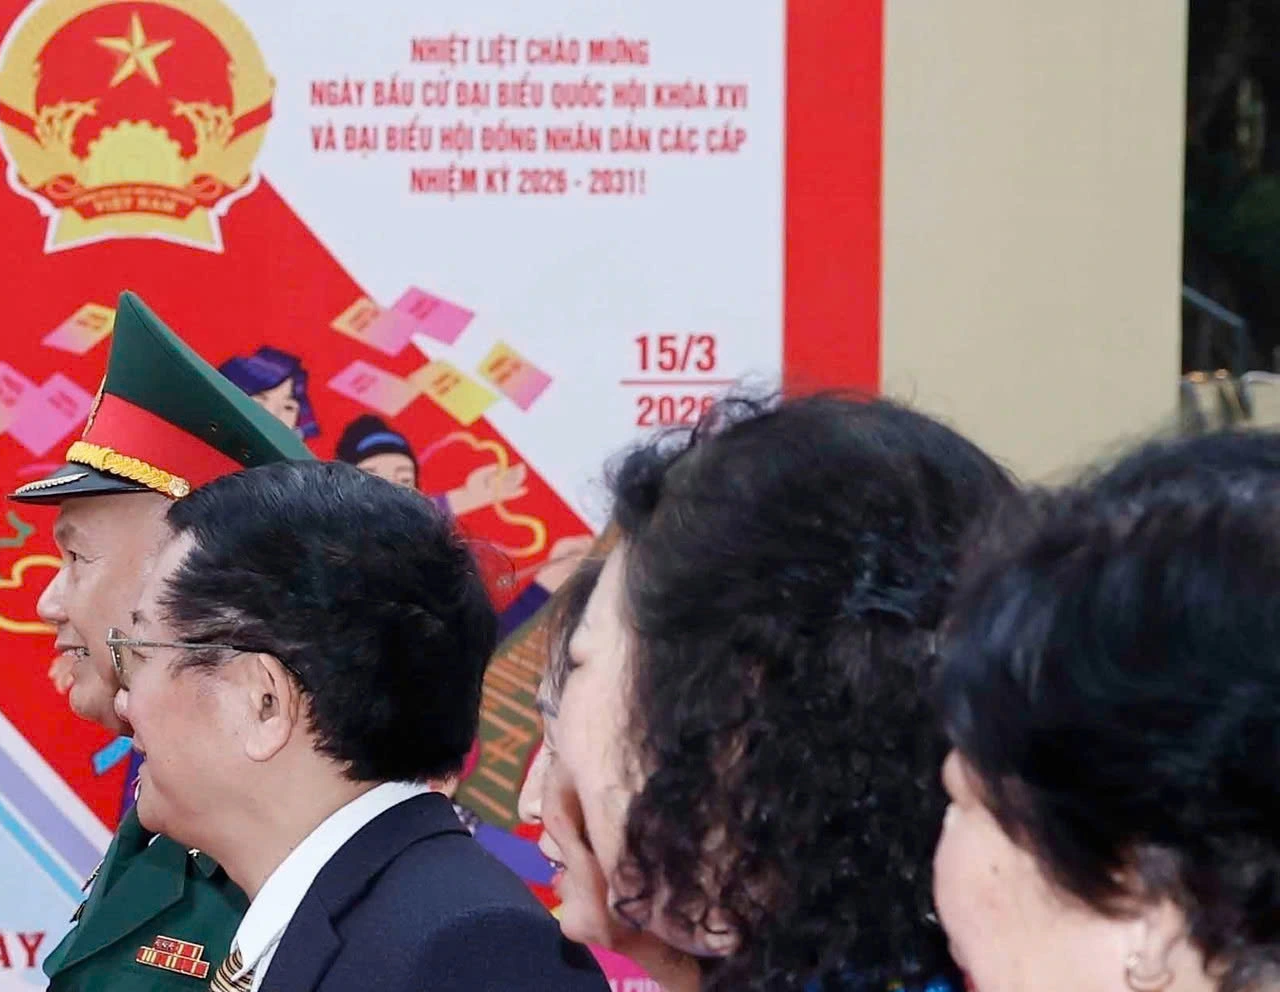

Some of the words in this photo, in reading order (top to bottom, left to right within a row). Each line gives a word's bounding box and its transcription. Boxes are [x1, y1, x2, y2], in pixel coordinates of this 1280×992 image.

[410, 34, 469, 68] NHIỆT
[477, 34, 517, 67] LIỆT
[526, 34, 580, 64] CHÀO
[588, 33, 650, 64] MỪNG
[311, 75, 365, 106] NGÀY
[373, 71, 414, 107] BẦU
[422, 69, 450, 107] CỬ
[456, 80, 490, 114] ĐẠI
[498, 71, 543, 108] BIỂU
[551, 74, 604, 109] QUỐC
[612, 77, 646, 114] HỘI
[653, 76, 707, 108] KHÓA
[716, 83, 748, 109] XVI
[311, 118, 336, 151] VÀ
[344, 125, 377, 158] ĐẠI
[386, 114, 432, 151] BIỂU
[440, 120, 473, 158] HỘI
[481, 118, 537, 151] ĐỒNG
[545, 122, 601, 151] NHÂN
[609, 121, 650, 151] DÂN
[658, 121, 698, 152] CÁC
[705, 117, 747, 152] CẤP
[410, 162, 477, 201] NHIỆM
[484, 161, 509, 193] KỲ
[518, 168, 567, 194] 2026
[589, 168, 645, 195] 2031!
[635, 335, 716, 372] 15/3
